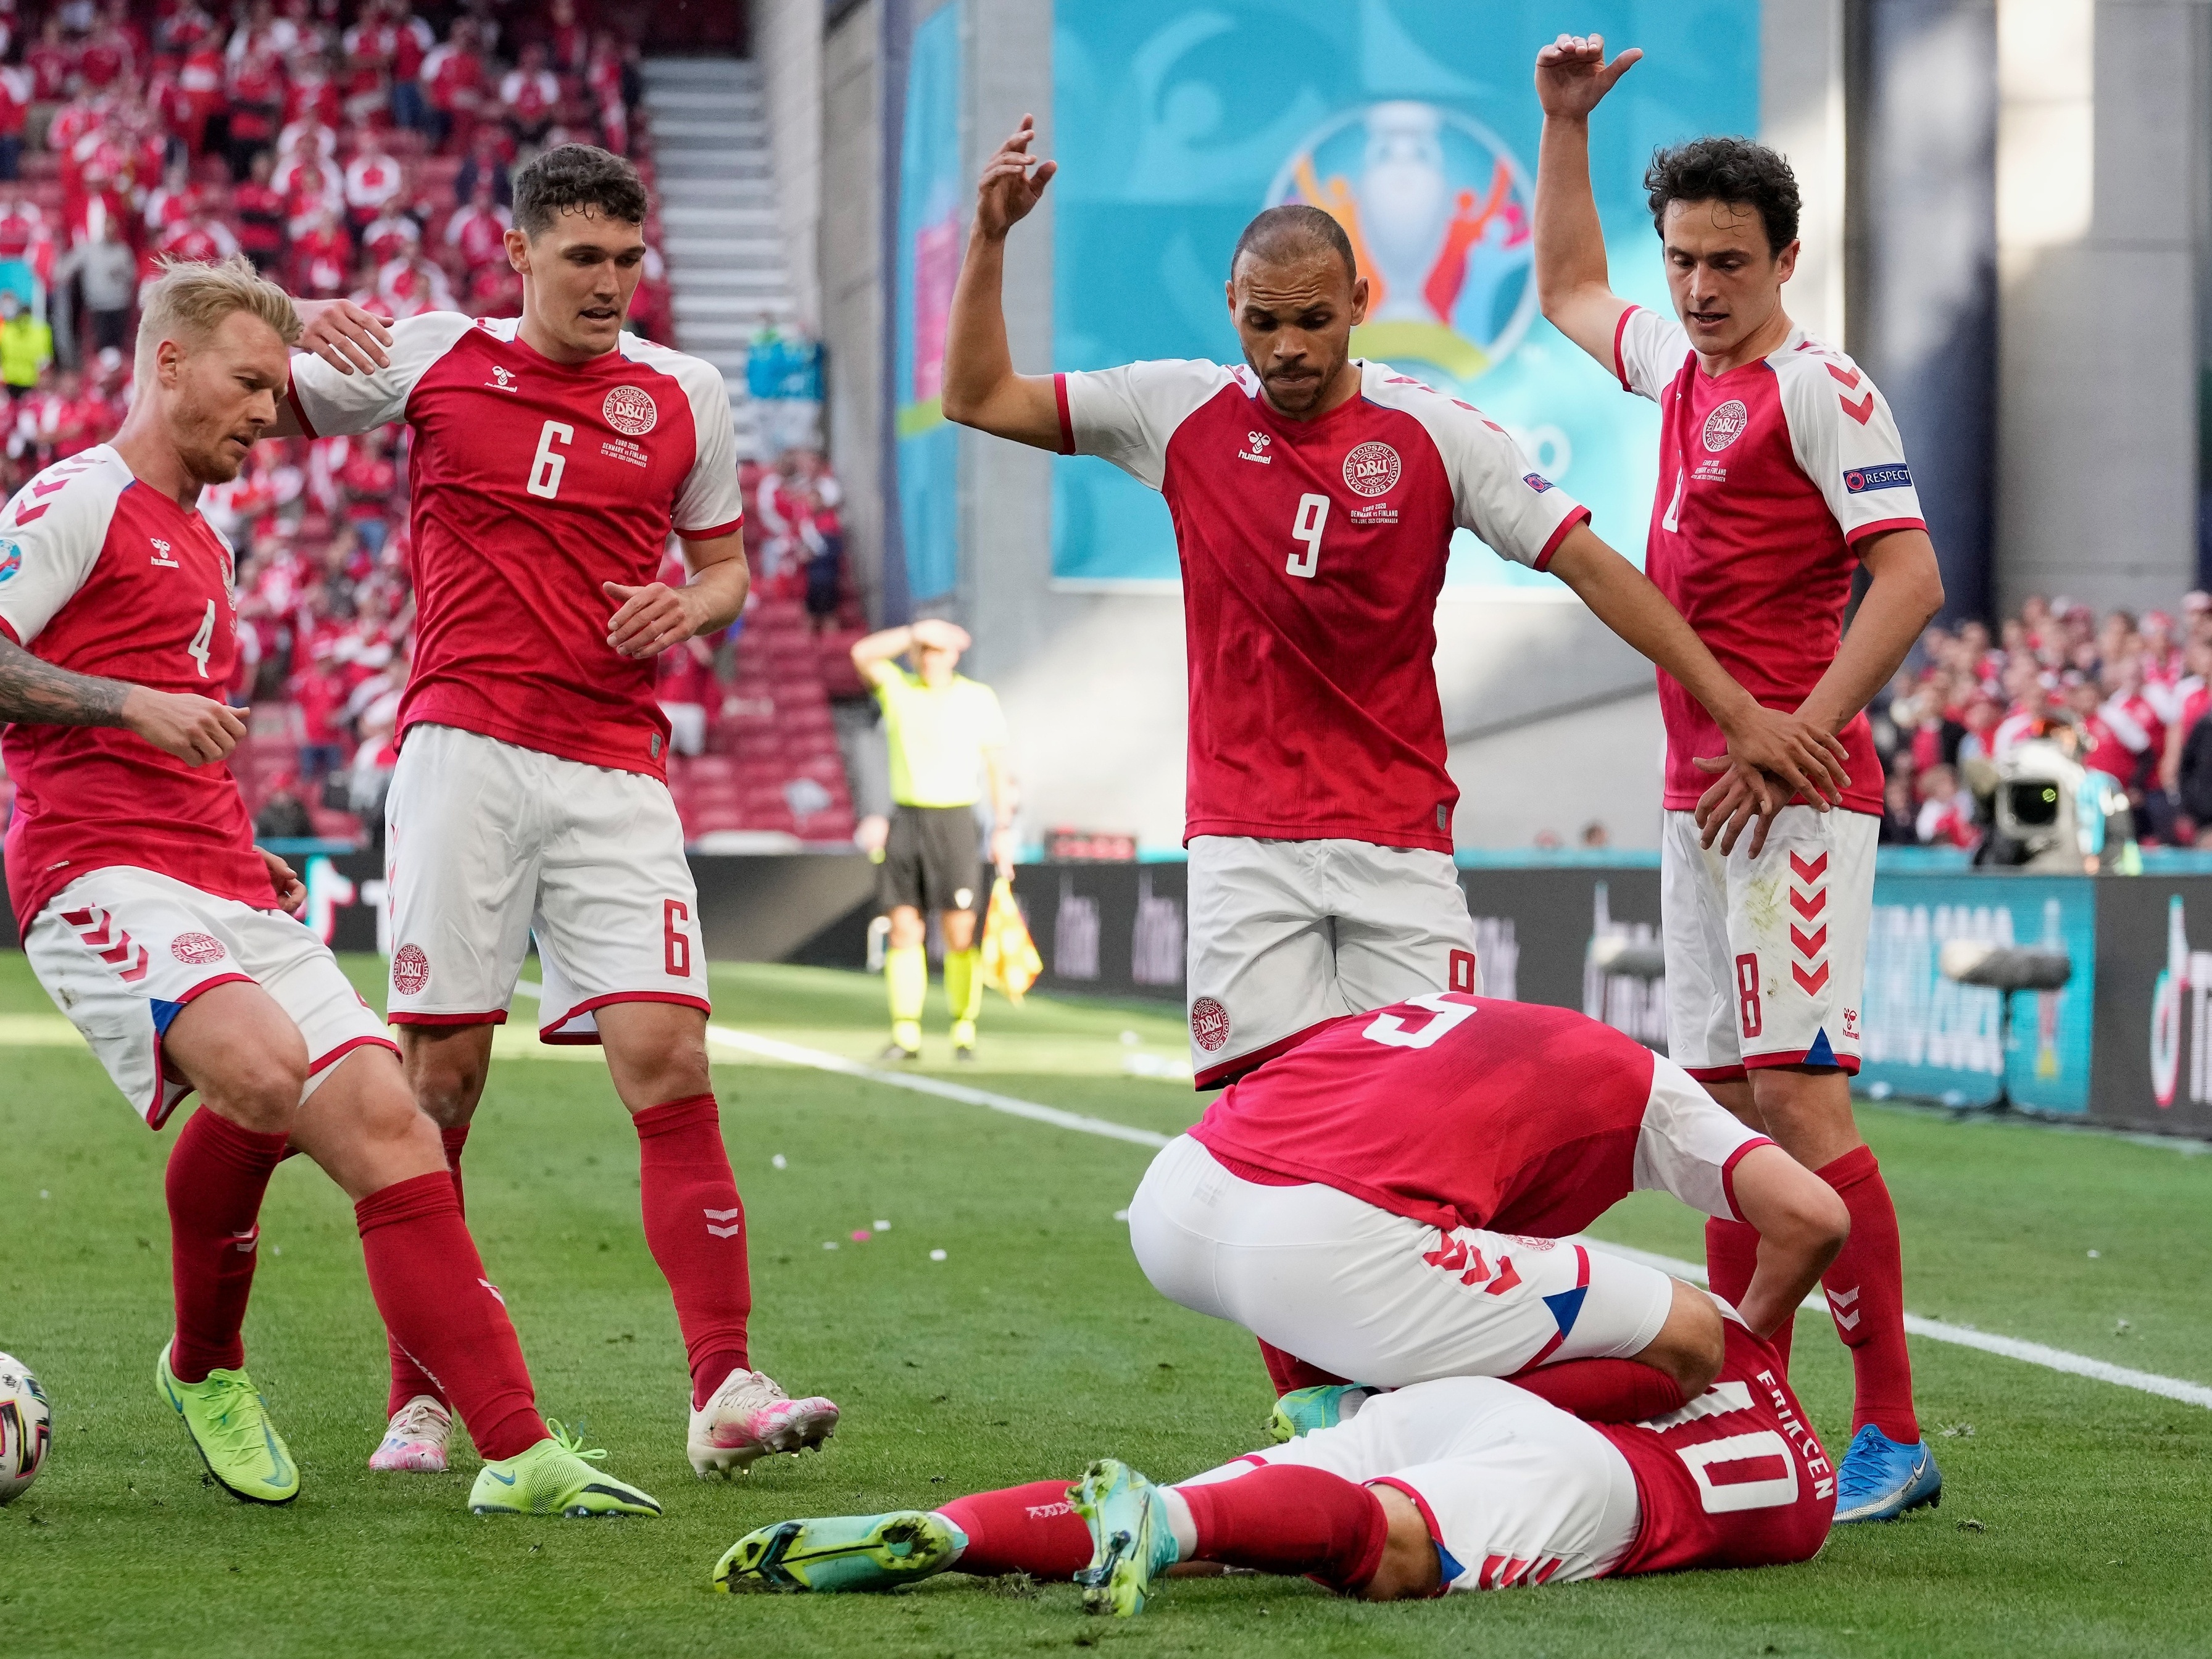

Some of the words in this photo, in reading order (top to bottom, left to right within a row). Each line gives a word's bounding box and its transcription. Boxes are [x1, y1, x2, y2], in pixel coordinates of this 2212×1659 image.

[614, 401, 645, 420] DBU
[1713, 417, 1739, 433] DBU
[526, 419, 575, 499] 6
[602, 442, 624, 454] DENMARK
[629, 451, 648, 462] FINLAND
[1237, 449, 1272, 465] hummel
[1355, 459, 1389, 478] DBU
[1865, 470, 1909, 484] RESPECT
[1364, 484, 1386, 494] 1889
[1350, 510, 1372, 518] DENMARK
[1285, 493, 1331, 578] 9
[187, 598, 216, 679] 4
[664, 898, 690, 977] 6
[400, 960, 422, 977] DBU
[401, 987, 417, 995] 1889
[1736, 952, 1762, 1039] 8
[1199, 1012, 1223, 1034] DBU
[1636, 1381, 1798, 1514] 10
